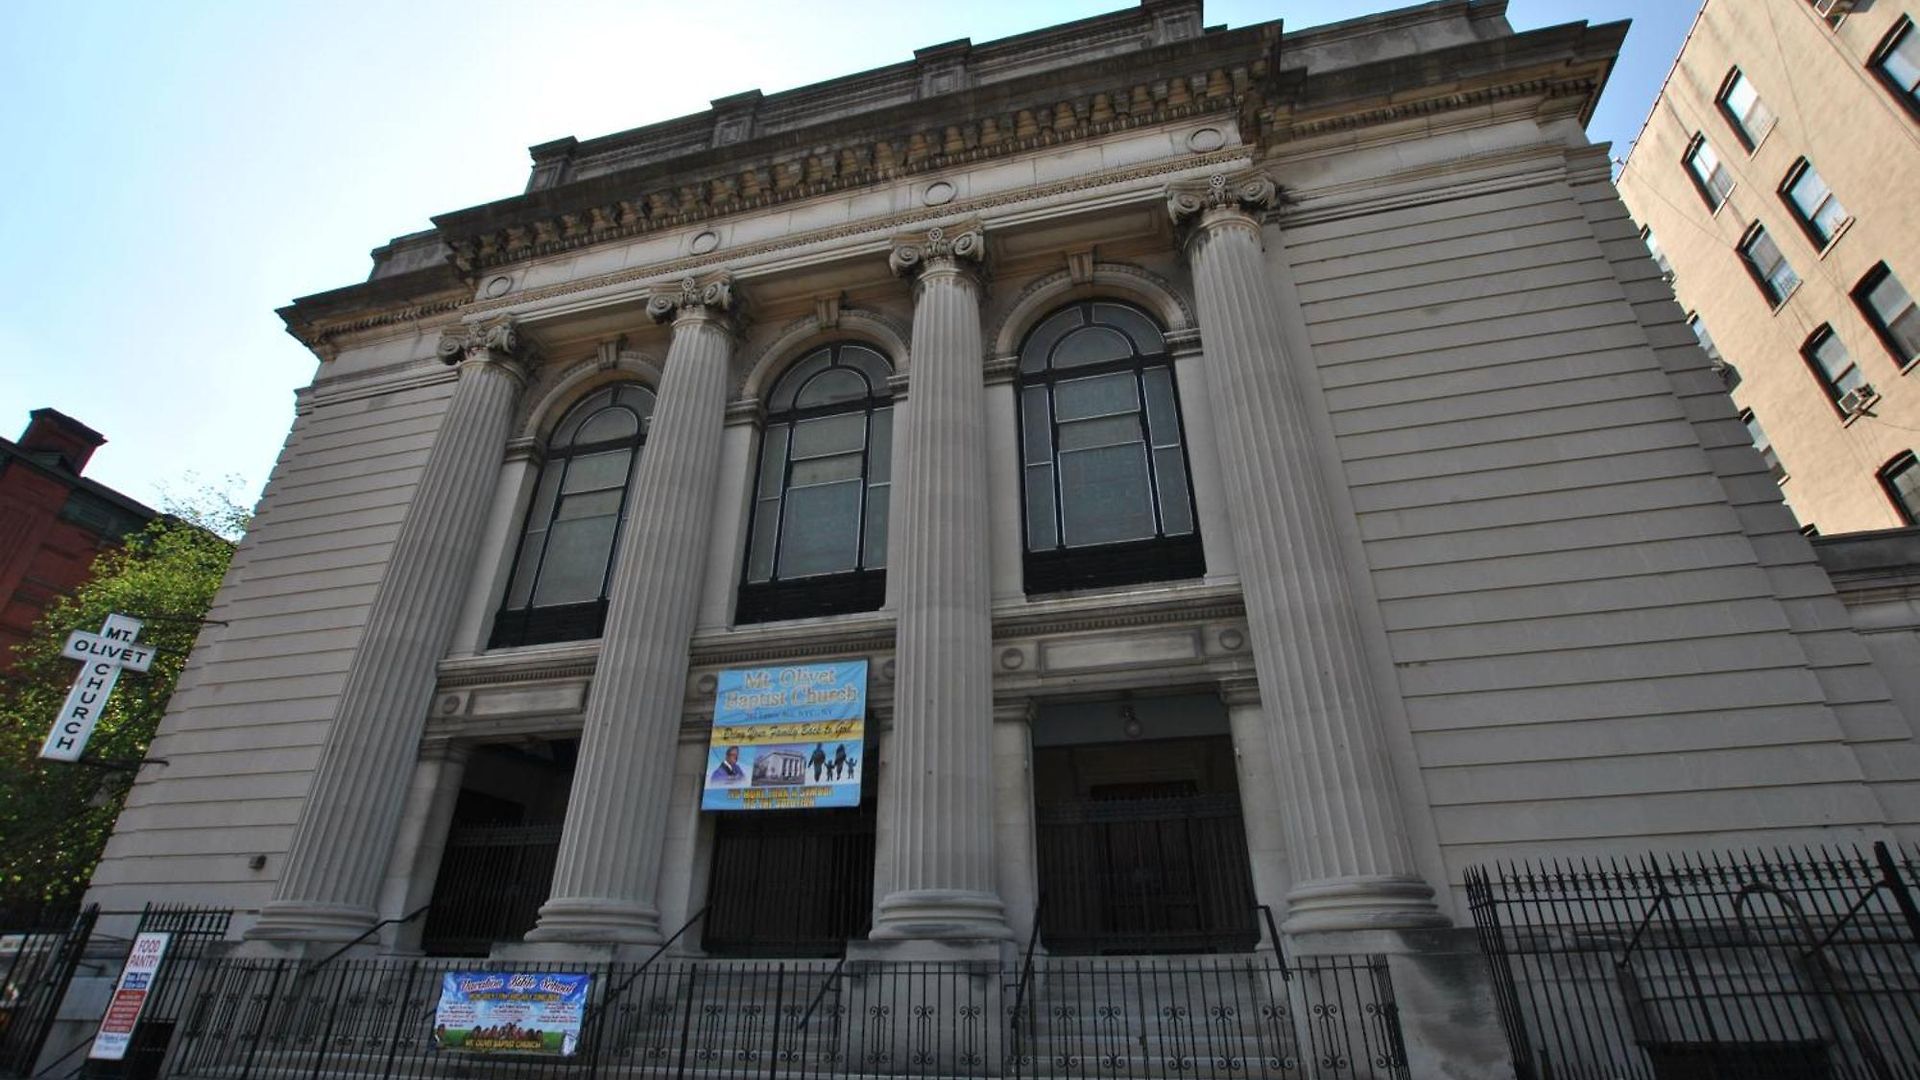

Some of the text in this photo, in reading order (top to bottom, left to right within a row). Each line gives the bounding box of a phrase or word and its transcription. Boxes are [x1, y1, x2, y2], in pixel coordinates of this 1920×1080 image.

[106, 627, 132, 642] MT.
[74, 639, 148, 663] OLIVET
[780, 667, 836, 686] Olivet
[56, 663, 110, 751] CHURCH
[725, 682, 858, 712] Baptist Church
[138, 940, 161, 953] FOOD
[129, 955, 159, 968] PANTRY
[509, 973, 537, 990] Bible
[540, 977, 577, 994] School
